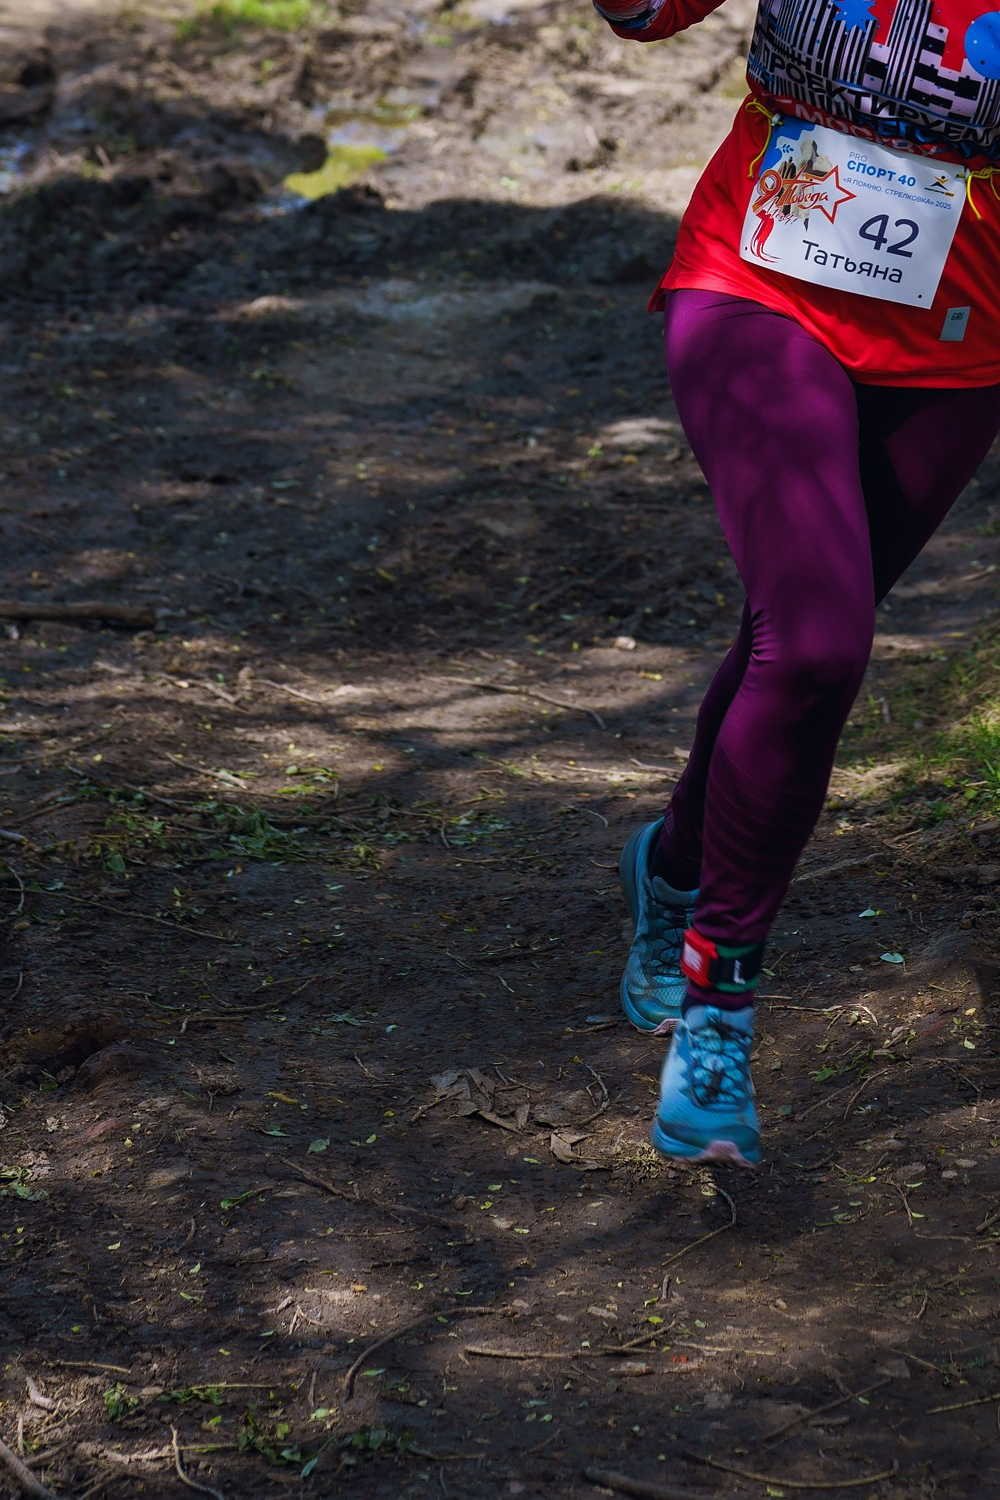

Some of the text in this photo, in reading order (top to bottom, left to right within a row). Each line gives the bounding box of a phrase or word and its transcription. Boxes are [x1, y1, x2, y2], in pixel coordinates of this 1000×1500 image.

[849, 151, 868, 162] PRO
[847, 160, 916, 187] СПОРТ 40
[935, 201, 952, 210] 2025
[858, 214, 920, 258] 42
[803, 240, 903, 284] Татьяна
